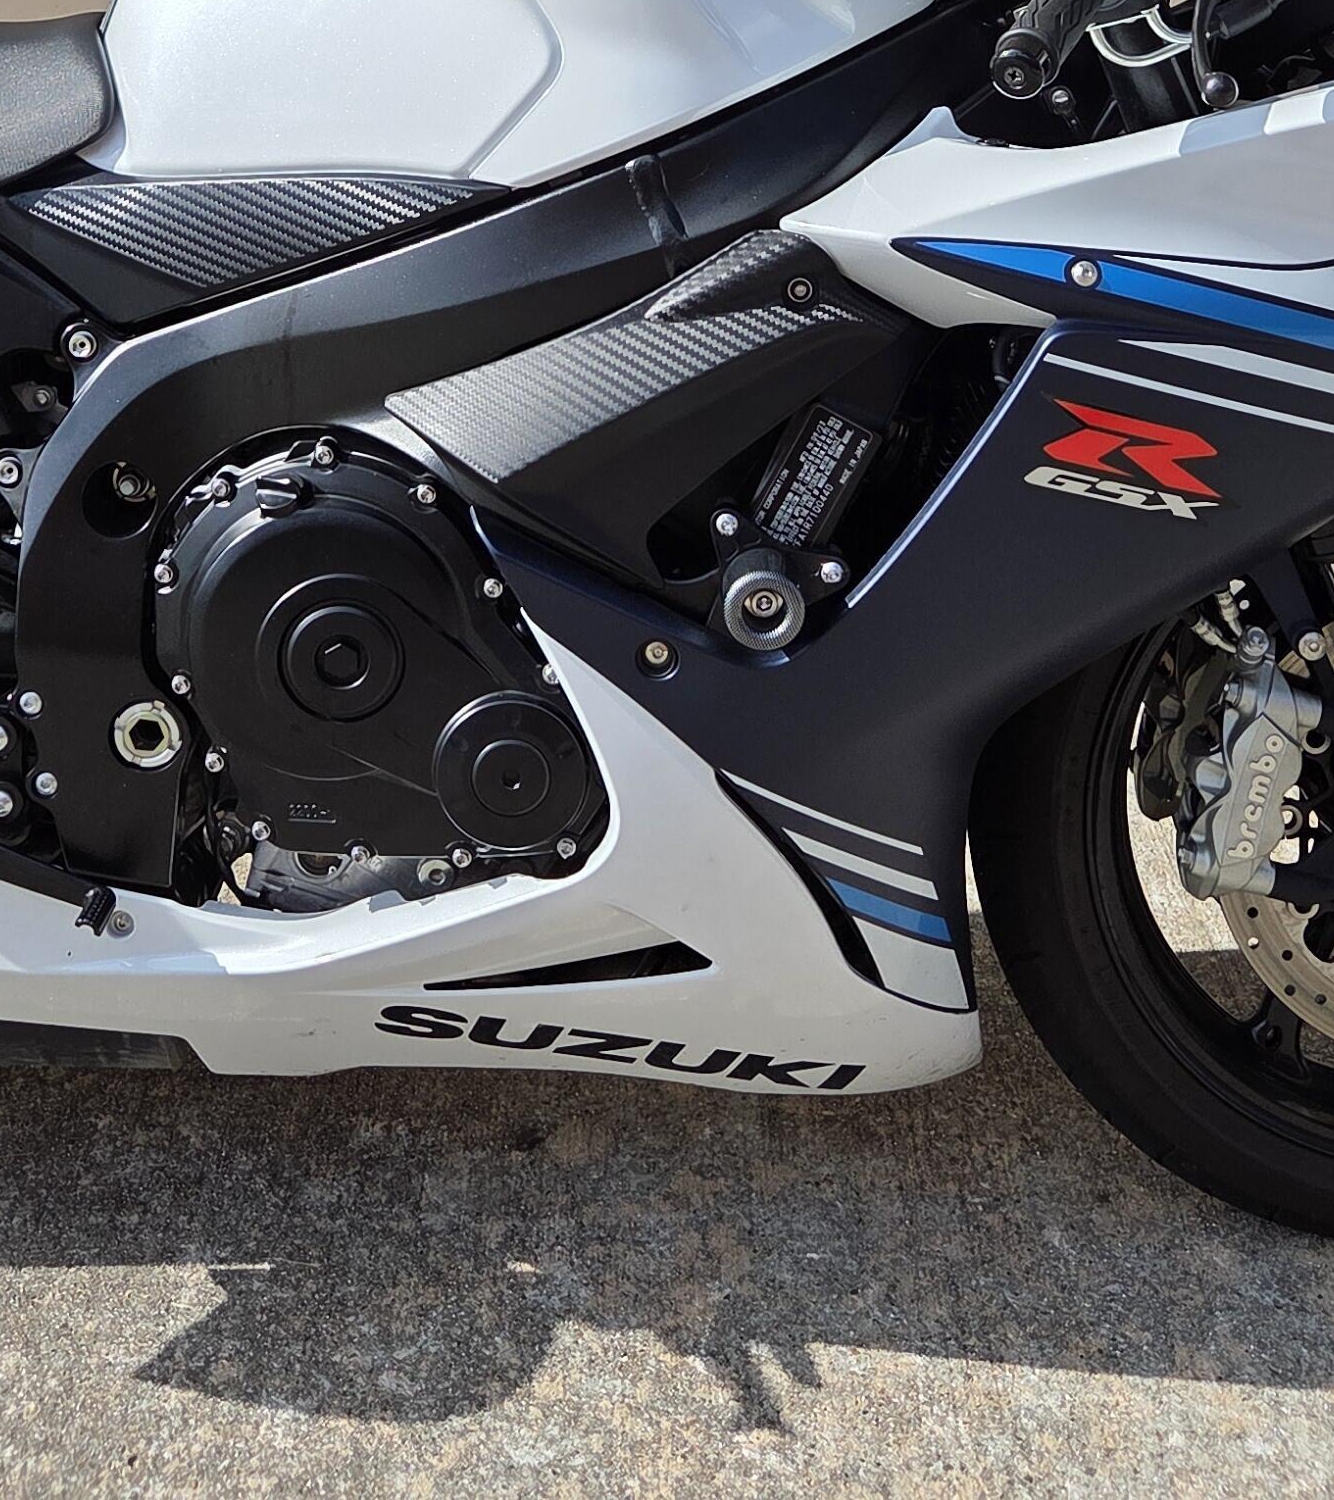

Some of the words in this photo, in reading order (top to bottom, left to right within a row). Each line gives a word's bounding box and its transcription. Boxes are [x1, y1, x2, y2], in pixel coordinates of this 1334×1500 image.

[1043, 399, 1222, 499] R
[793, 483, 835, 547] FA1R7100440
[1024, 466, 1219, 520] GSX
[1227, 734, 1284, 859] brembo
[374, 1005, 867, 1090] SUZUKI
